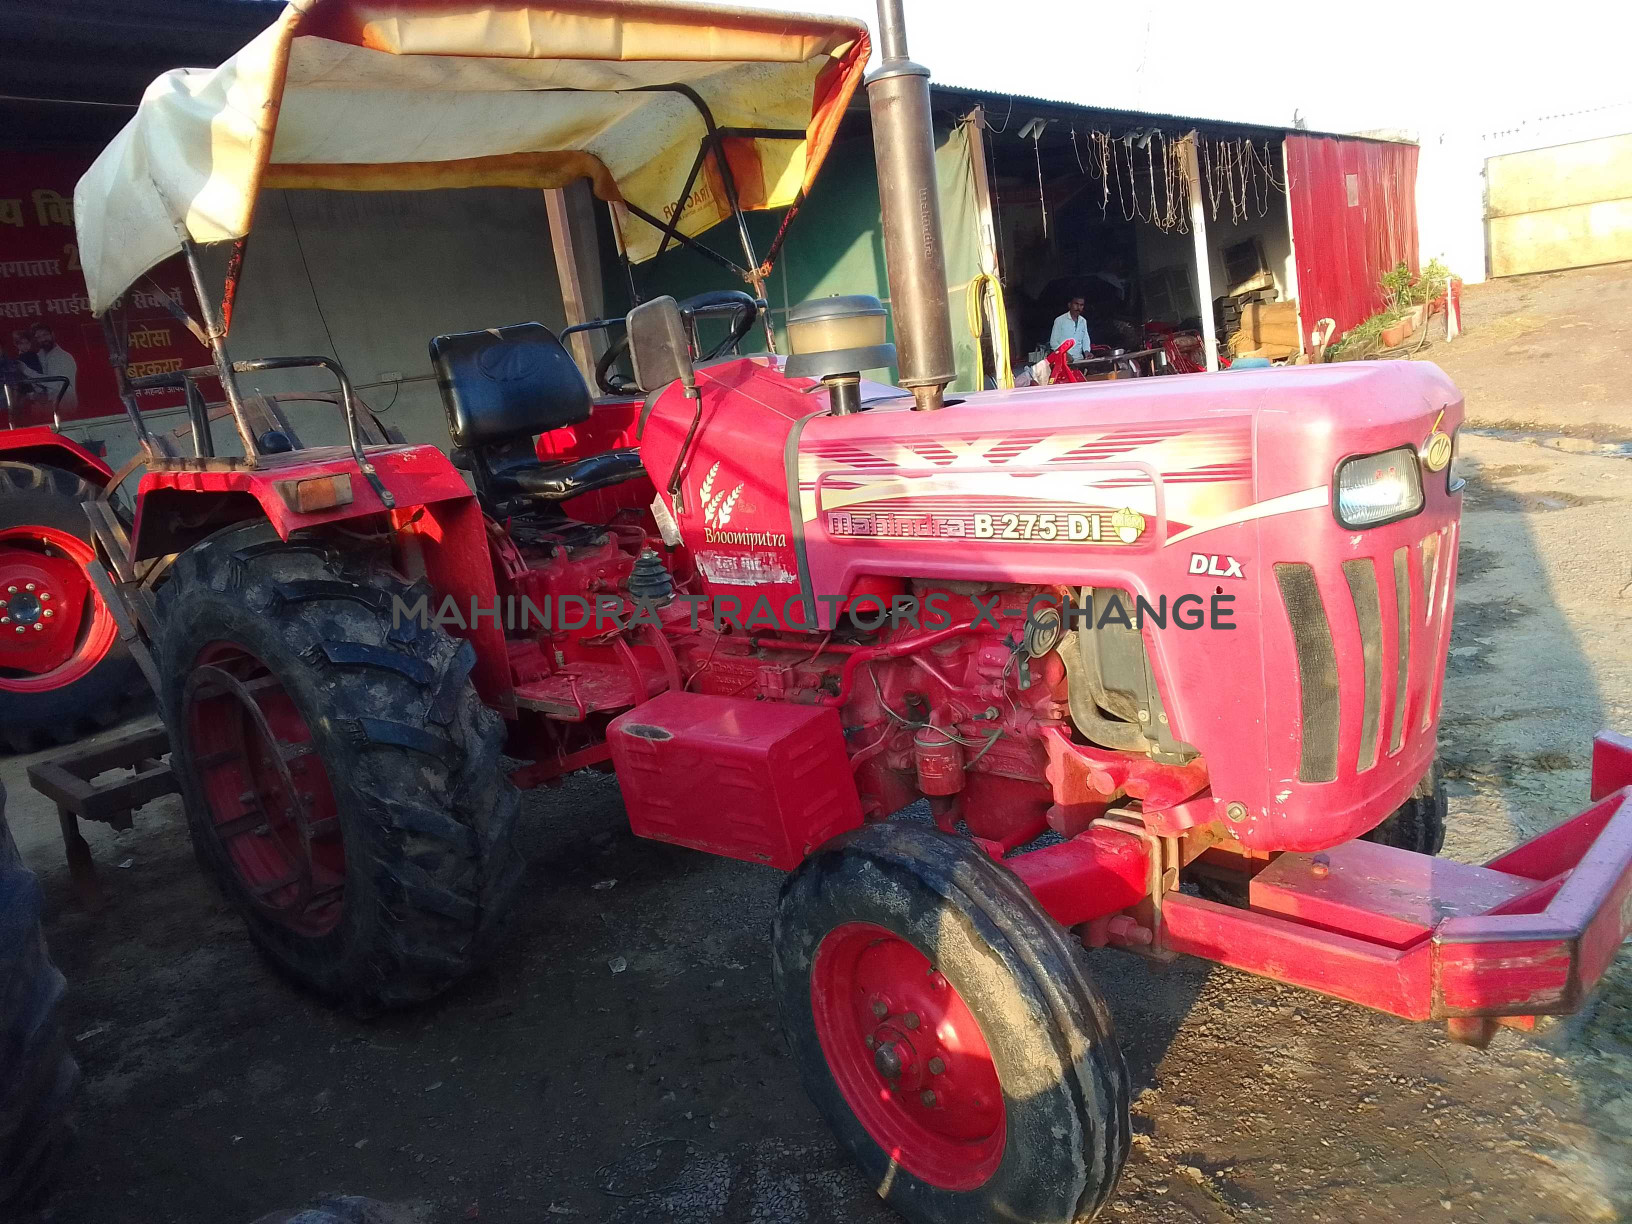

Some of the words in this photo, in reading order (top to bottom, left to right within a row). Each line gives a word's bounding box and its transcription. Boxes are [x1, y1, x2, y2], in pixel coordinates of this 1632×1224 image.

[704, 527, 787, 552] Bhoomiputra
[974, 513, 994, 540] B
[1001, 513, 1058, 541] 275
[1067, 514, 1101, 541] DI
[1188, 553, 1245, 579] DLX
